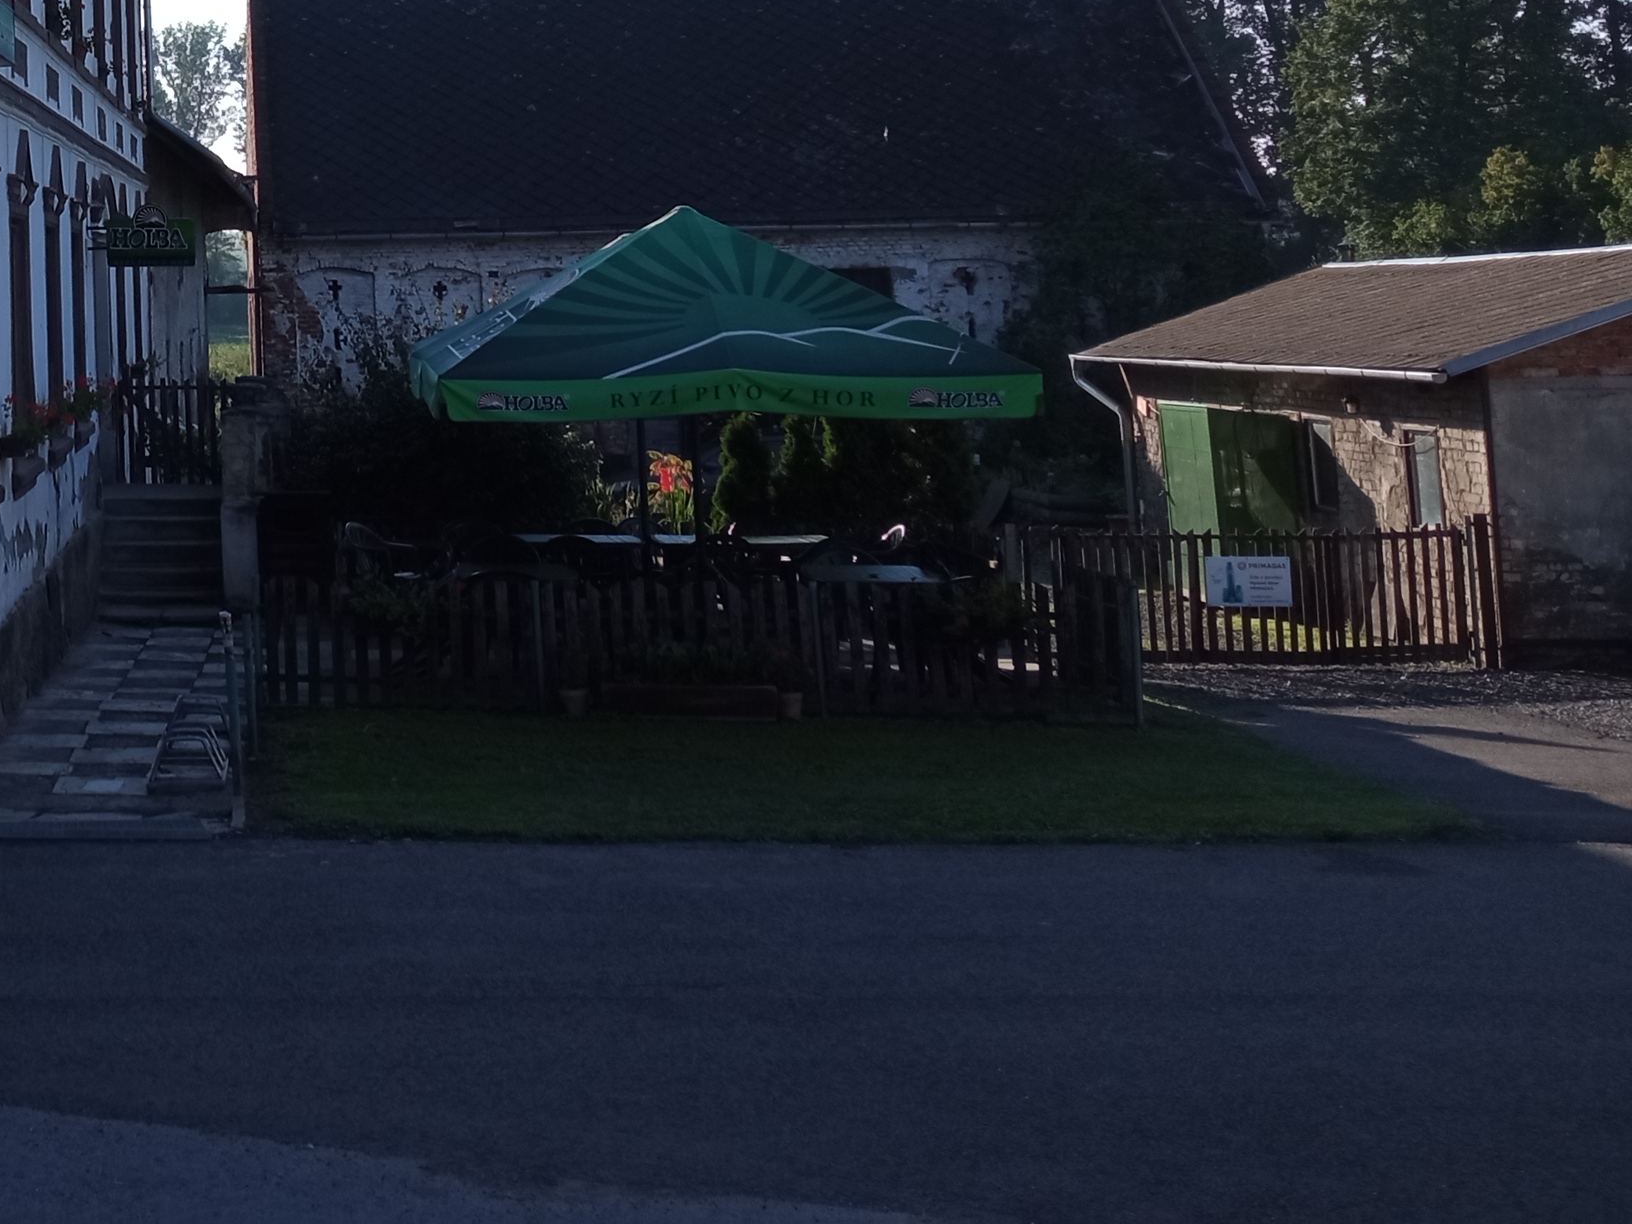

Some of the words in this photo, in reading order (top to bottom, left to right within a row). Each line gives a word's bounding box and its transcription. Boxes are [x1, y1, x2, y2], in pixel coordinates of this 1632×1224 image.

[109, 227, 188, 250] HOLBA
[502, 394, 569, 411] HOLBA
[610, 384, 679, 409] RYZÍ
[695, 383, 763, 402] PIVO
[779, 387, 794, 403] Z
[812, 389, 876, 408] HOR
[934, 391, 1005, 408] HOLBA
